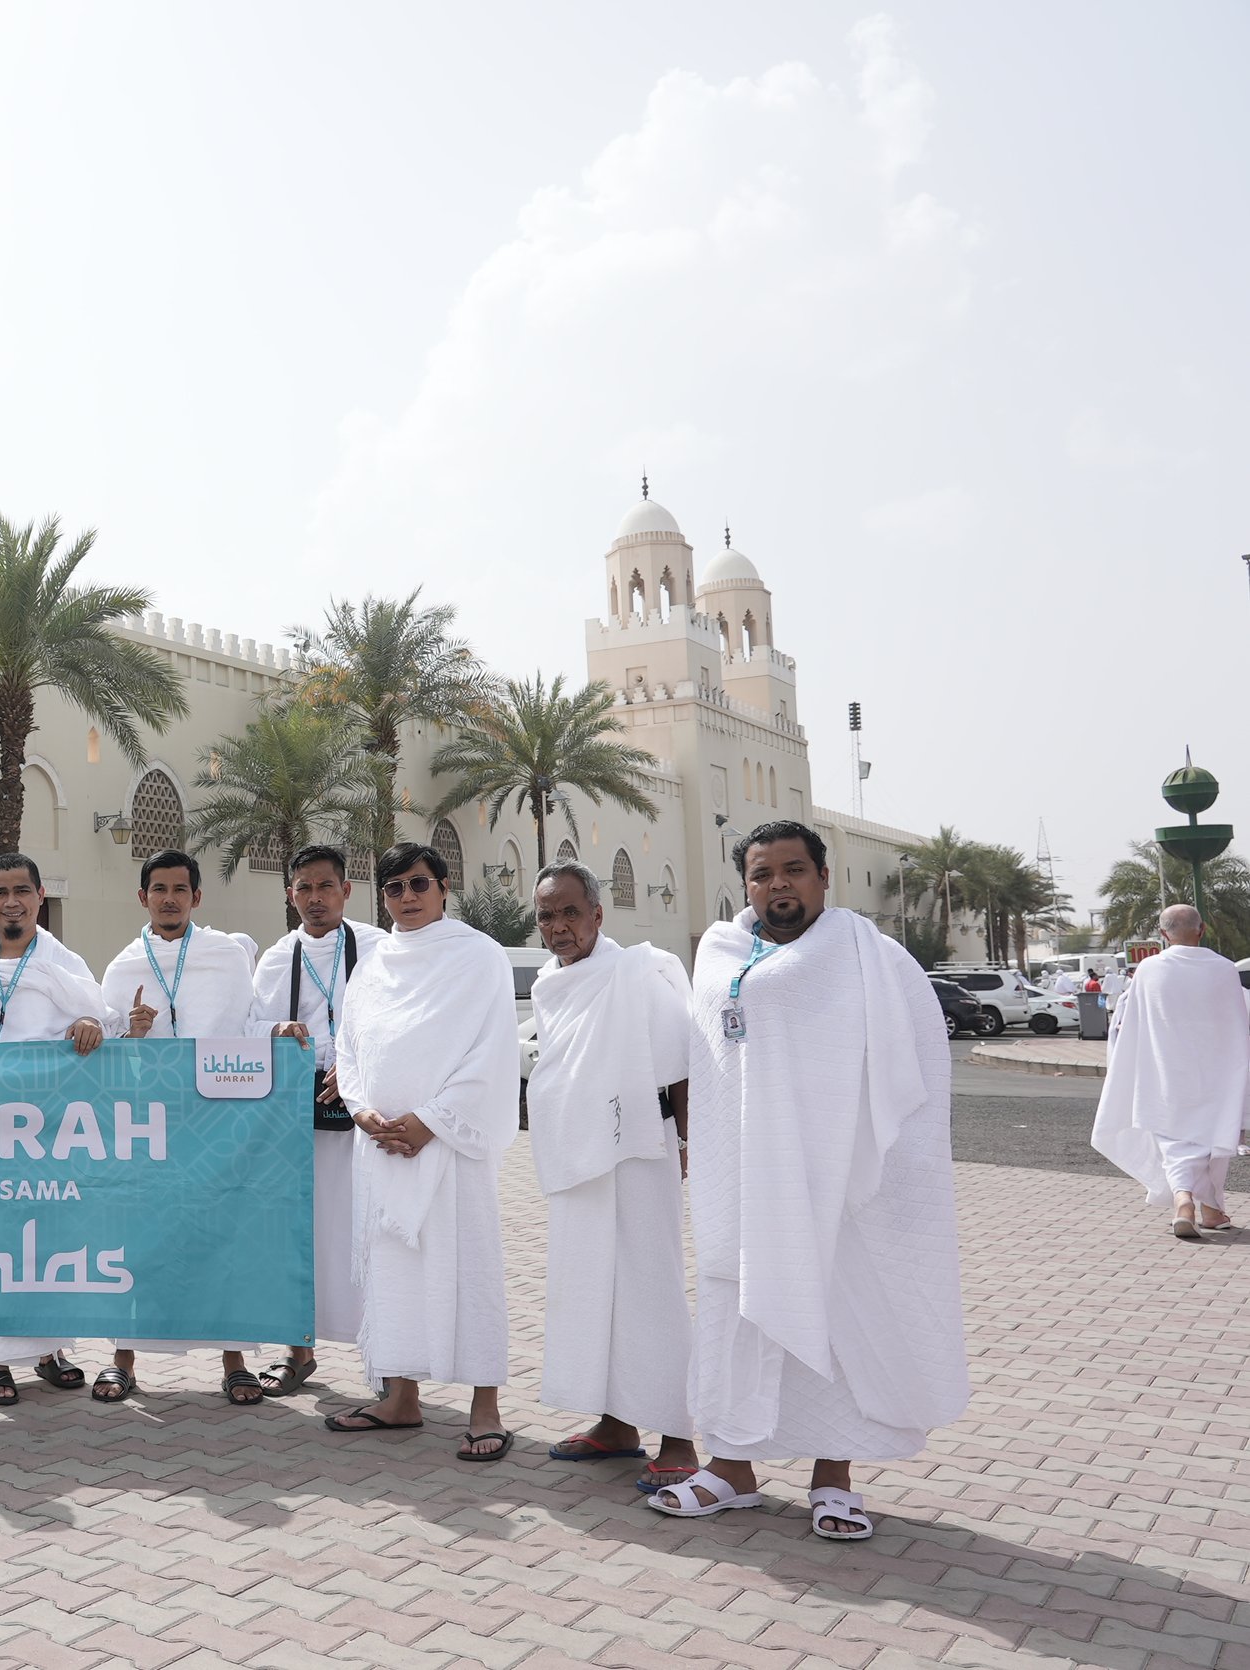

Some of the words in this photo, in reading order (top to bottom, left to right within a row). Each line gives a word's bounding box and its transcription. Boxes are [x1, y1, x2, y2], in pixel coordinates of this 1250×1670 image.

[204, 1054, 265, 1073] ikhlas
[215, 1075, 254, 1083] UMRAH
[323, 1110, 350, 1118] ikhlas
